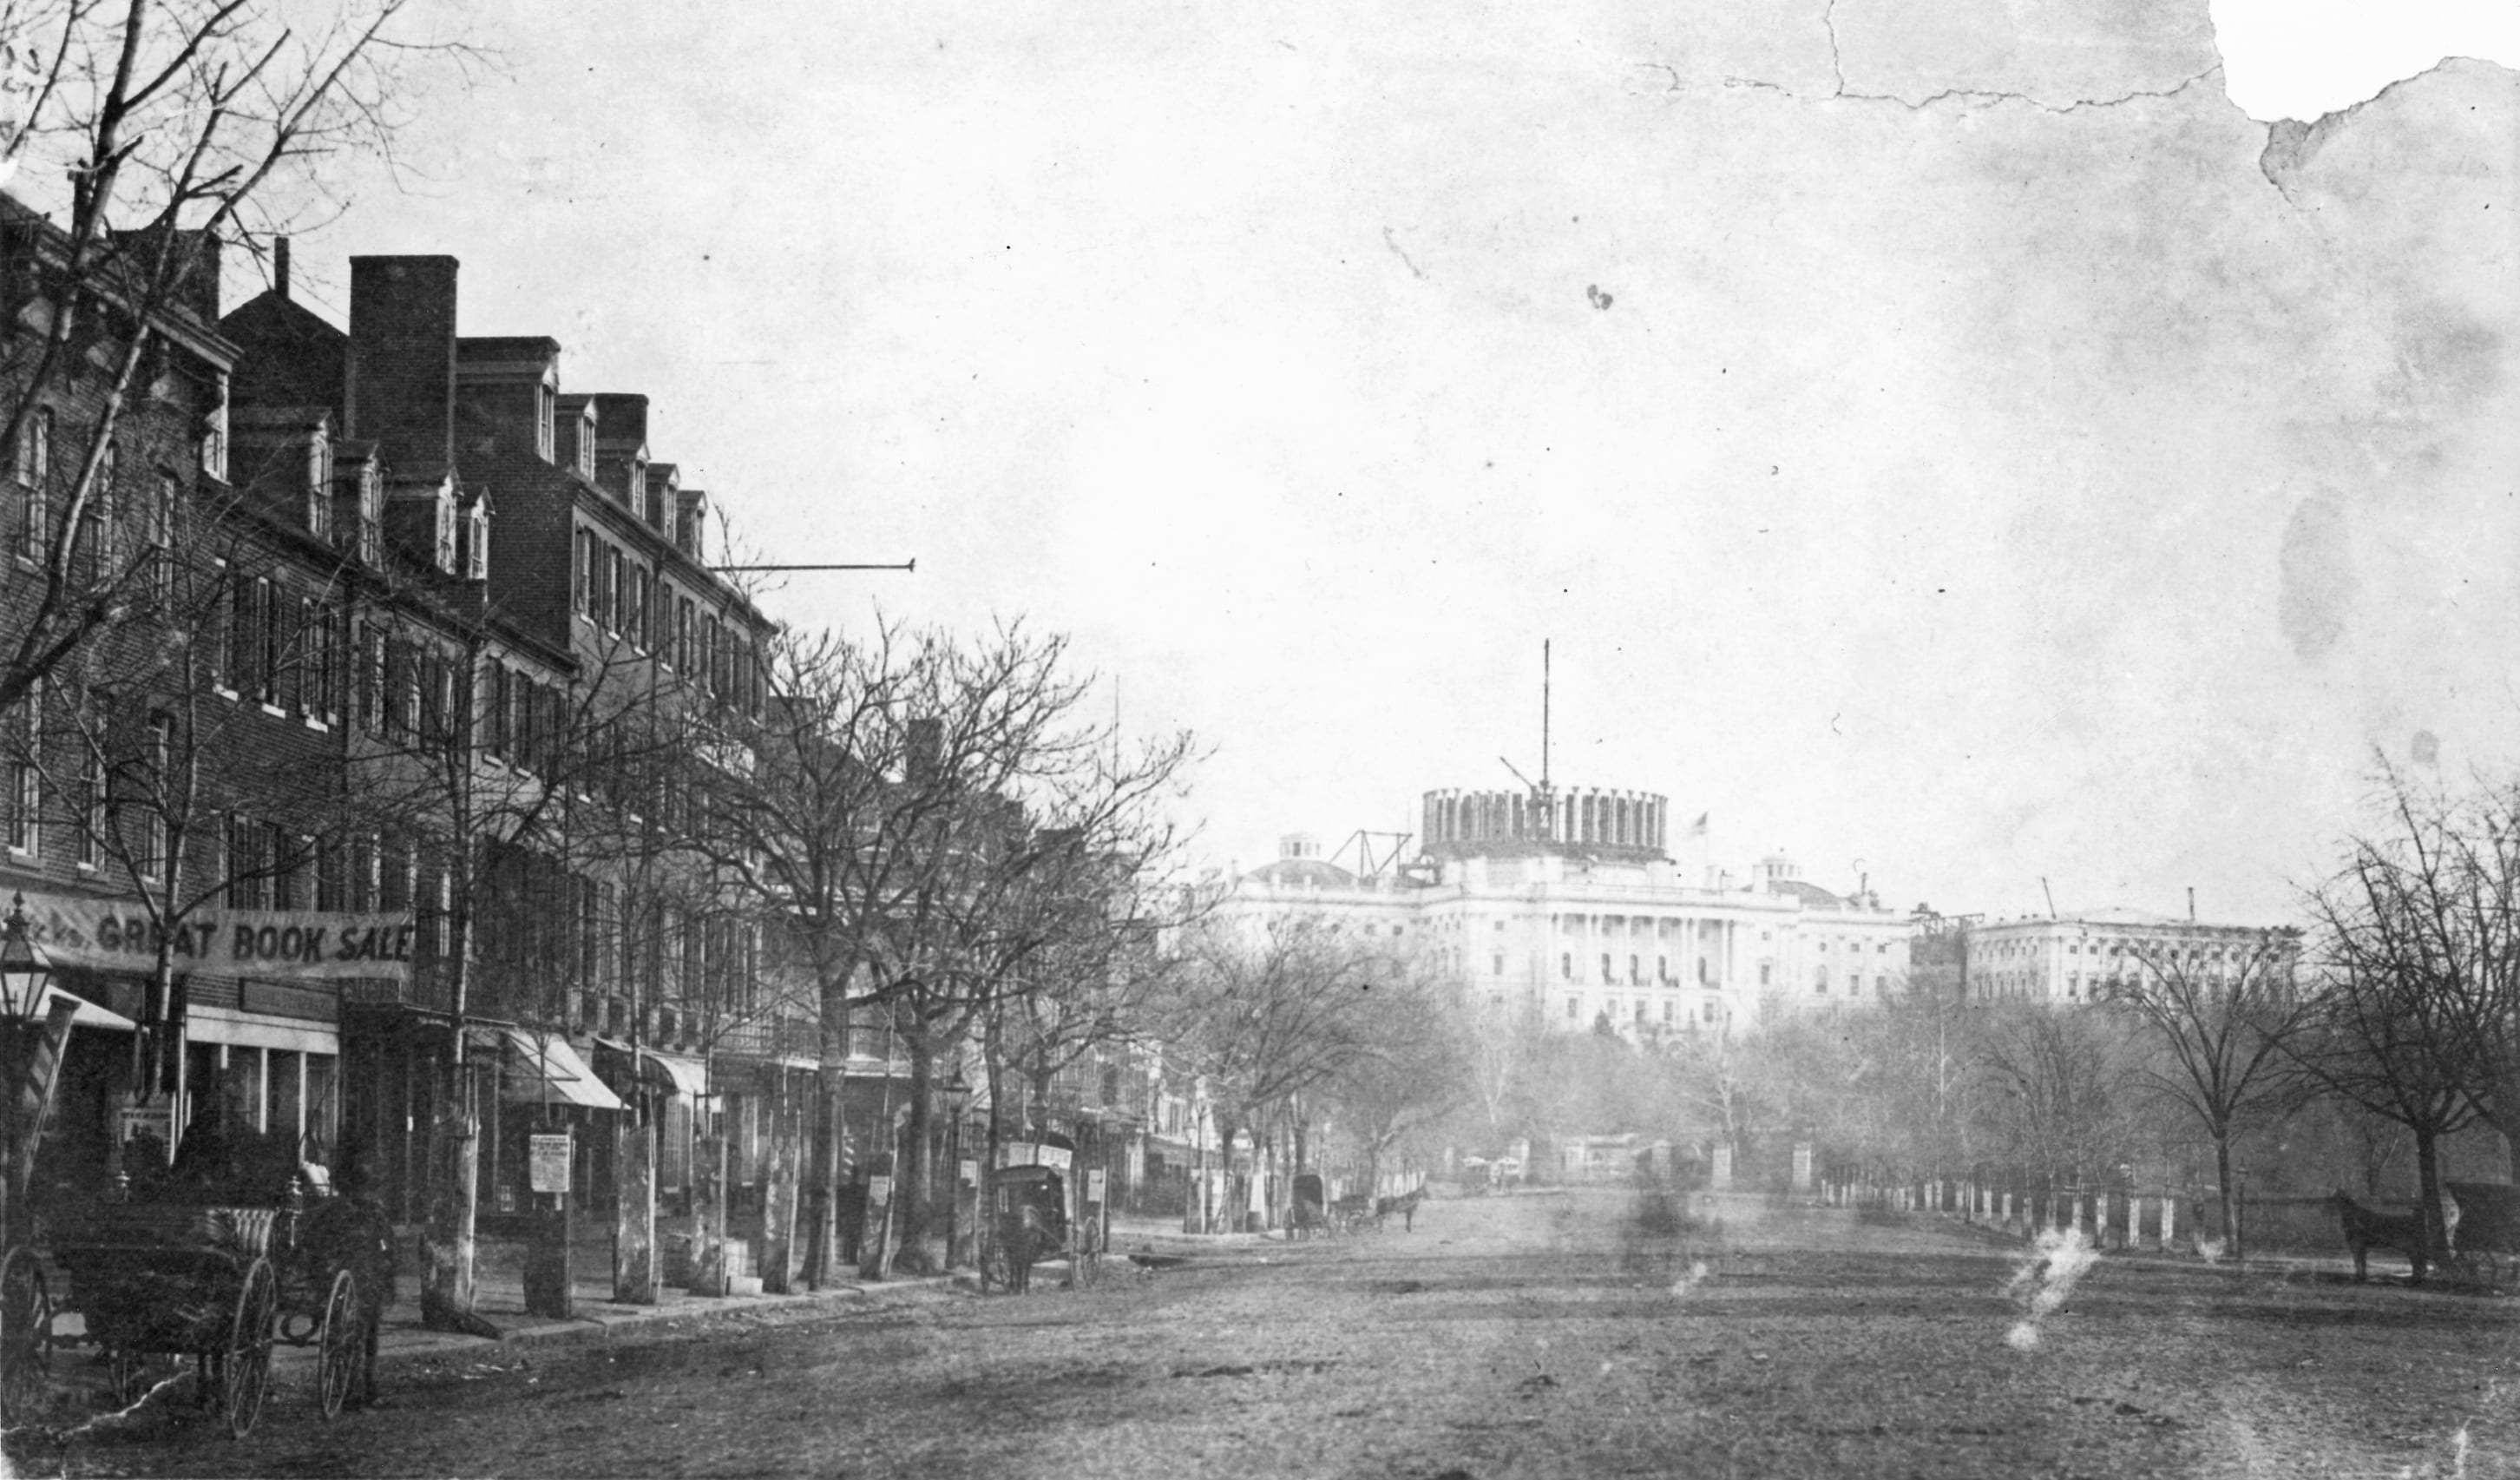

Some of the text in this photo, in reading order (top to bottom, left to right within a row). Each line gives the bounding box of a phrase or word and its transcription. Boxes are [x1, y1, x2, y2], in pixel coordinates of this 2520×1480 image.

[95, 917, 217, 958] GREAT
[234, 925, 326, 961] BOOK
[337, 924, 413, 962] SALE
